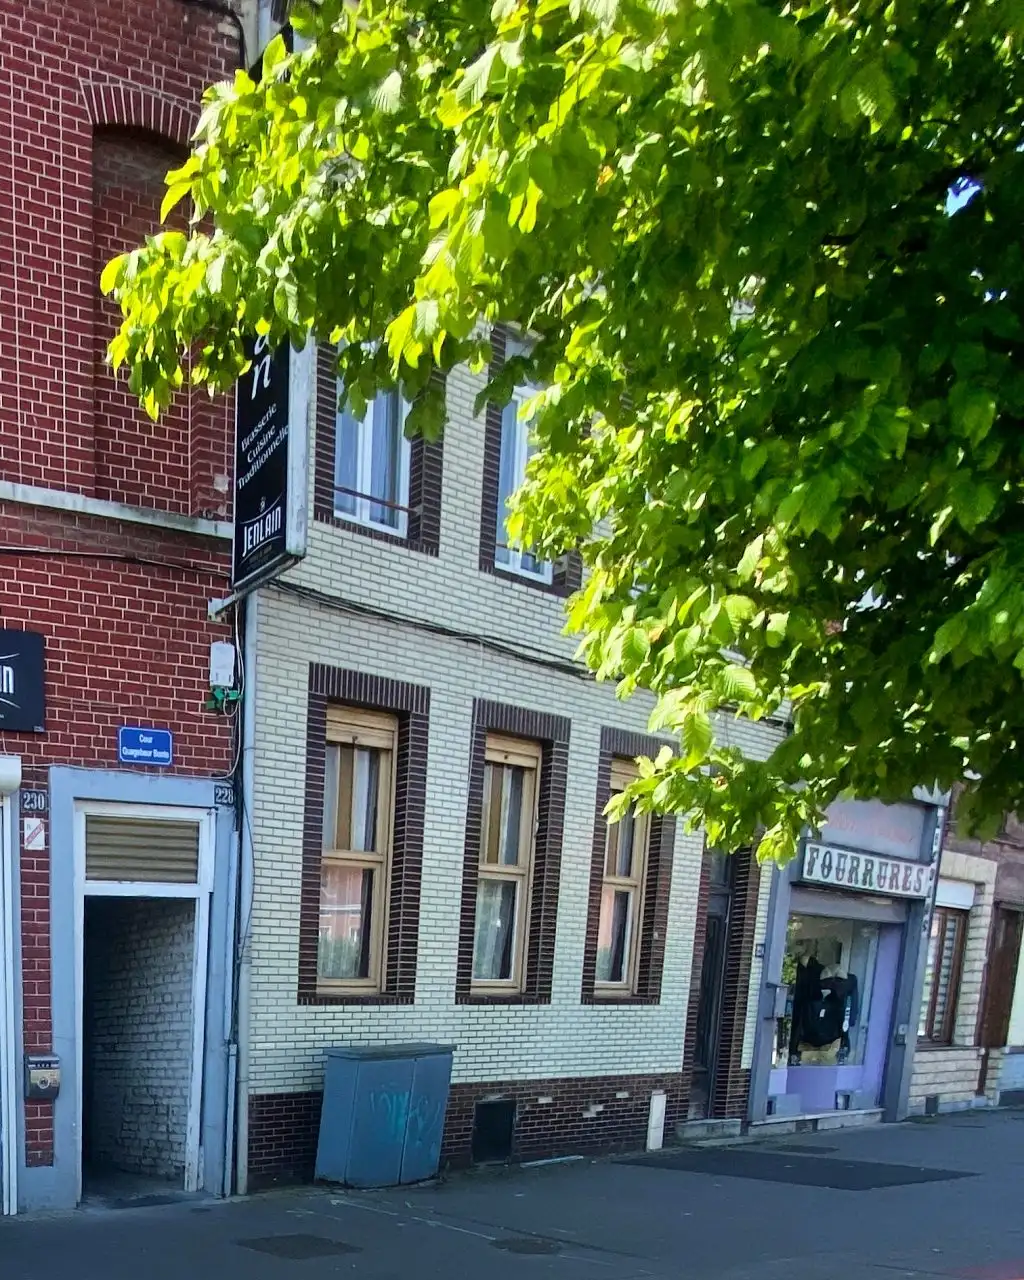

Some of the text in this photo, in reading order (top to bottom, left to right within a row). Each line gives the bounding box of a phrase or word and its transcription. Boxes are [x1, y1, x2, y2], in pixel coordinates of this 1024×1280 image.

[241, 402, 277, 453] Brasserie
[247, 424, 276, 463] Cuisine
[237, 424, 289, 490] Traditionnelle
[242, 506, 281, 557] JENLAIN
[139, 734, 153, 744] Cour
[23, 791, 45, 810] 230
[215, 786, 234, 804] 228
[806, 846, 924, 893] FOURRURES
